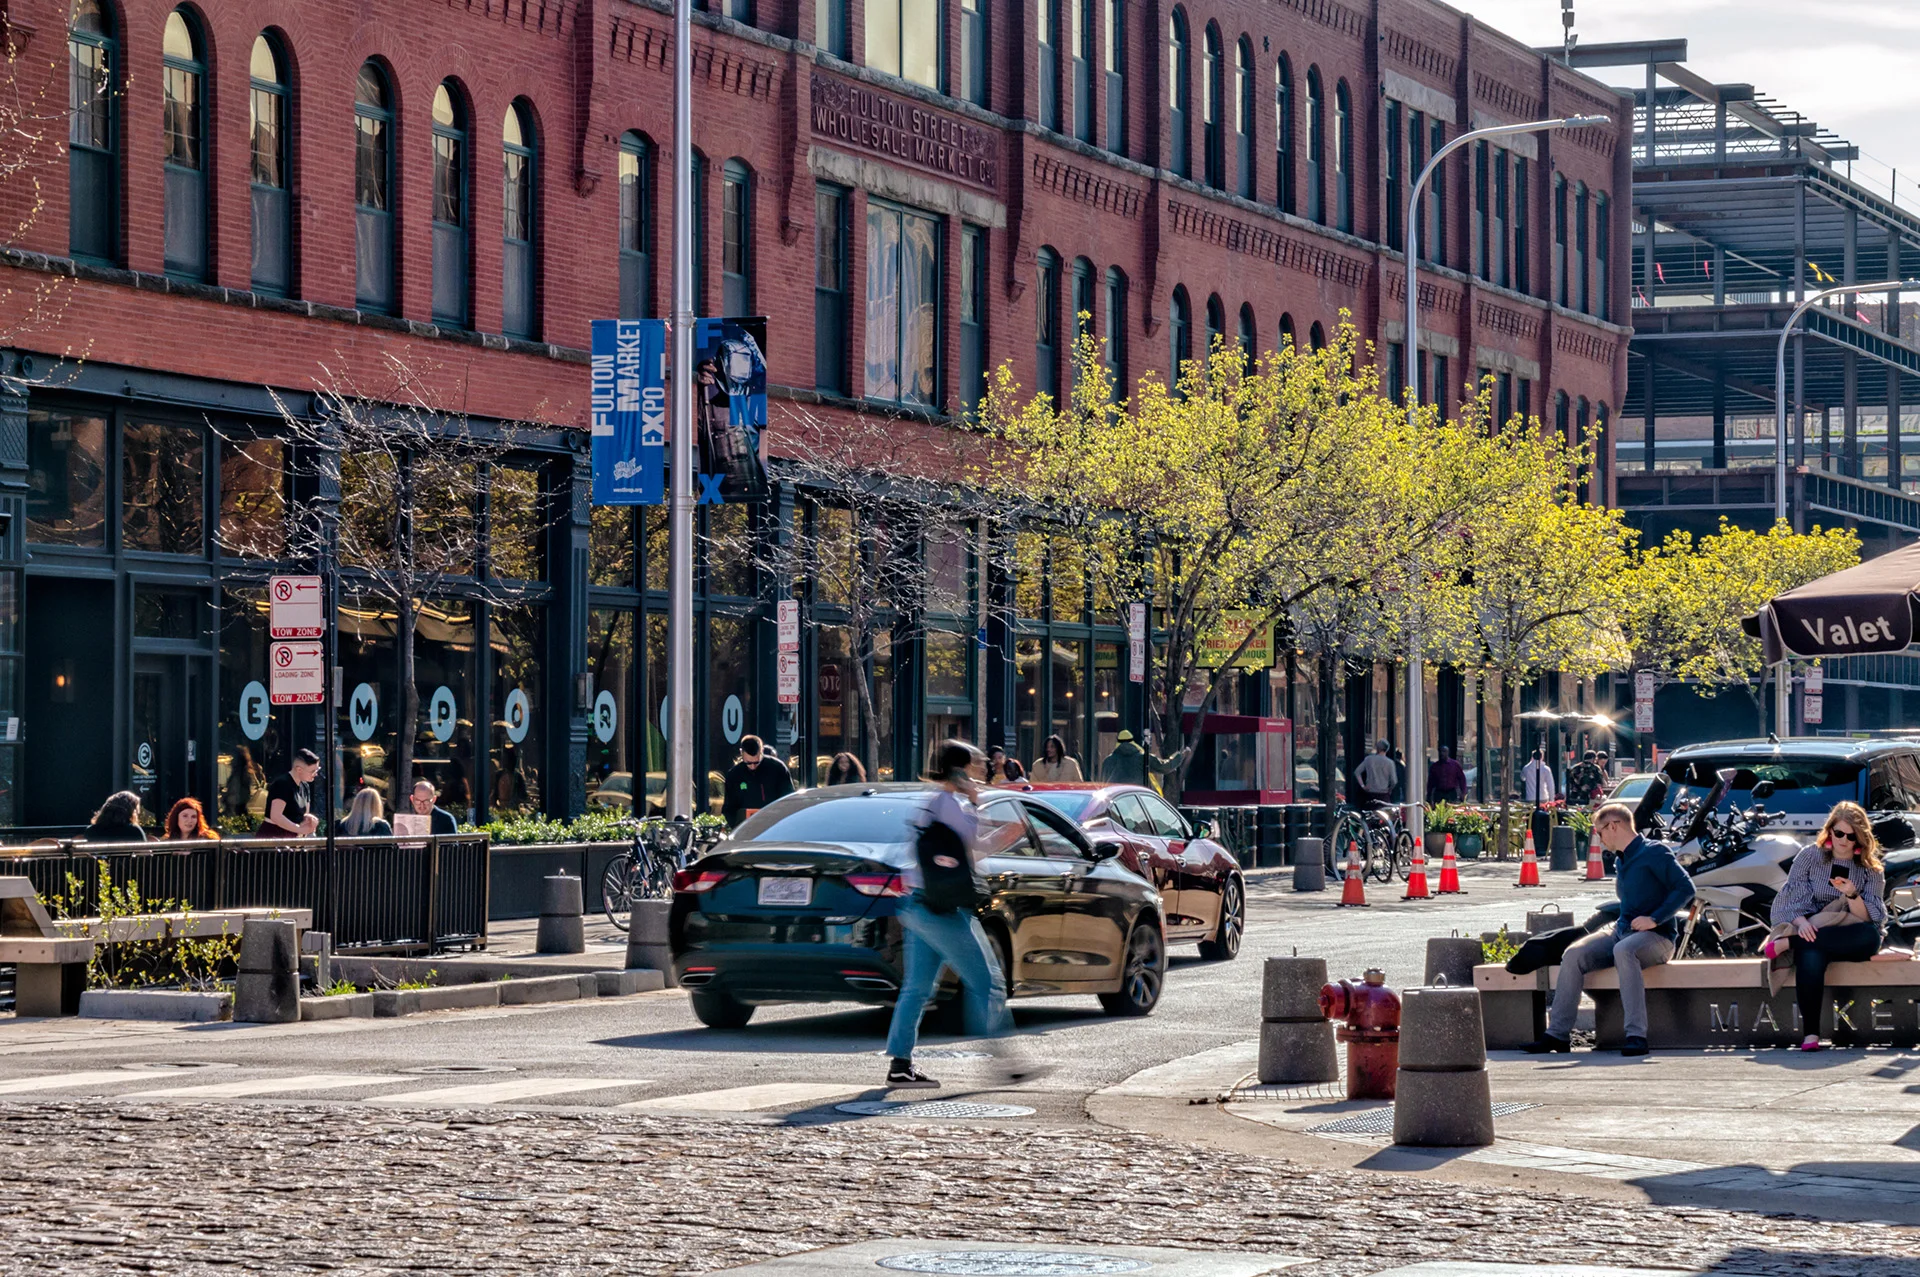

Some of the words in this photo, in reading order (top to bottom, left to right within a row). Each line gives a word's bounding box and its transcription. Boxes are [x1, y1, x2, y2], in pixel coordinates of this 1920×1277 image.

[850, 89, 905, 129] FULTON
[912, 109, 967, 148] STREET
[815, 106, 908, 158] WHOLESALE
[915, 137, 973, 177] MARKET
[617, 319, 641, 412] MARKET
[591, 354, 615, 437] FULTON
[642, 387, 665, 446] EXPO
[698, 473, 726, 505] X
[275, 628, 293, 637] TOW
[296, 627, 319, 636] ZONE
[1203, 639, 1227, 649] RIED
[1801, 615, 1896, 646] Valet
[274, 671, 298, 679] LOADING
[275, 694, 294, 702] TOW
[296, 693, 319, 702] ZONE
